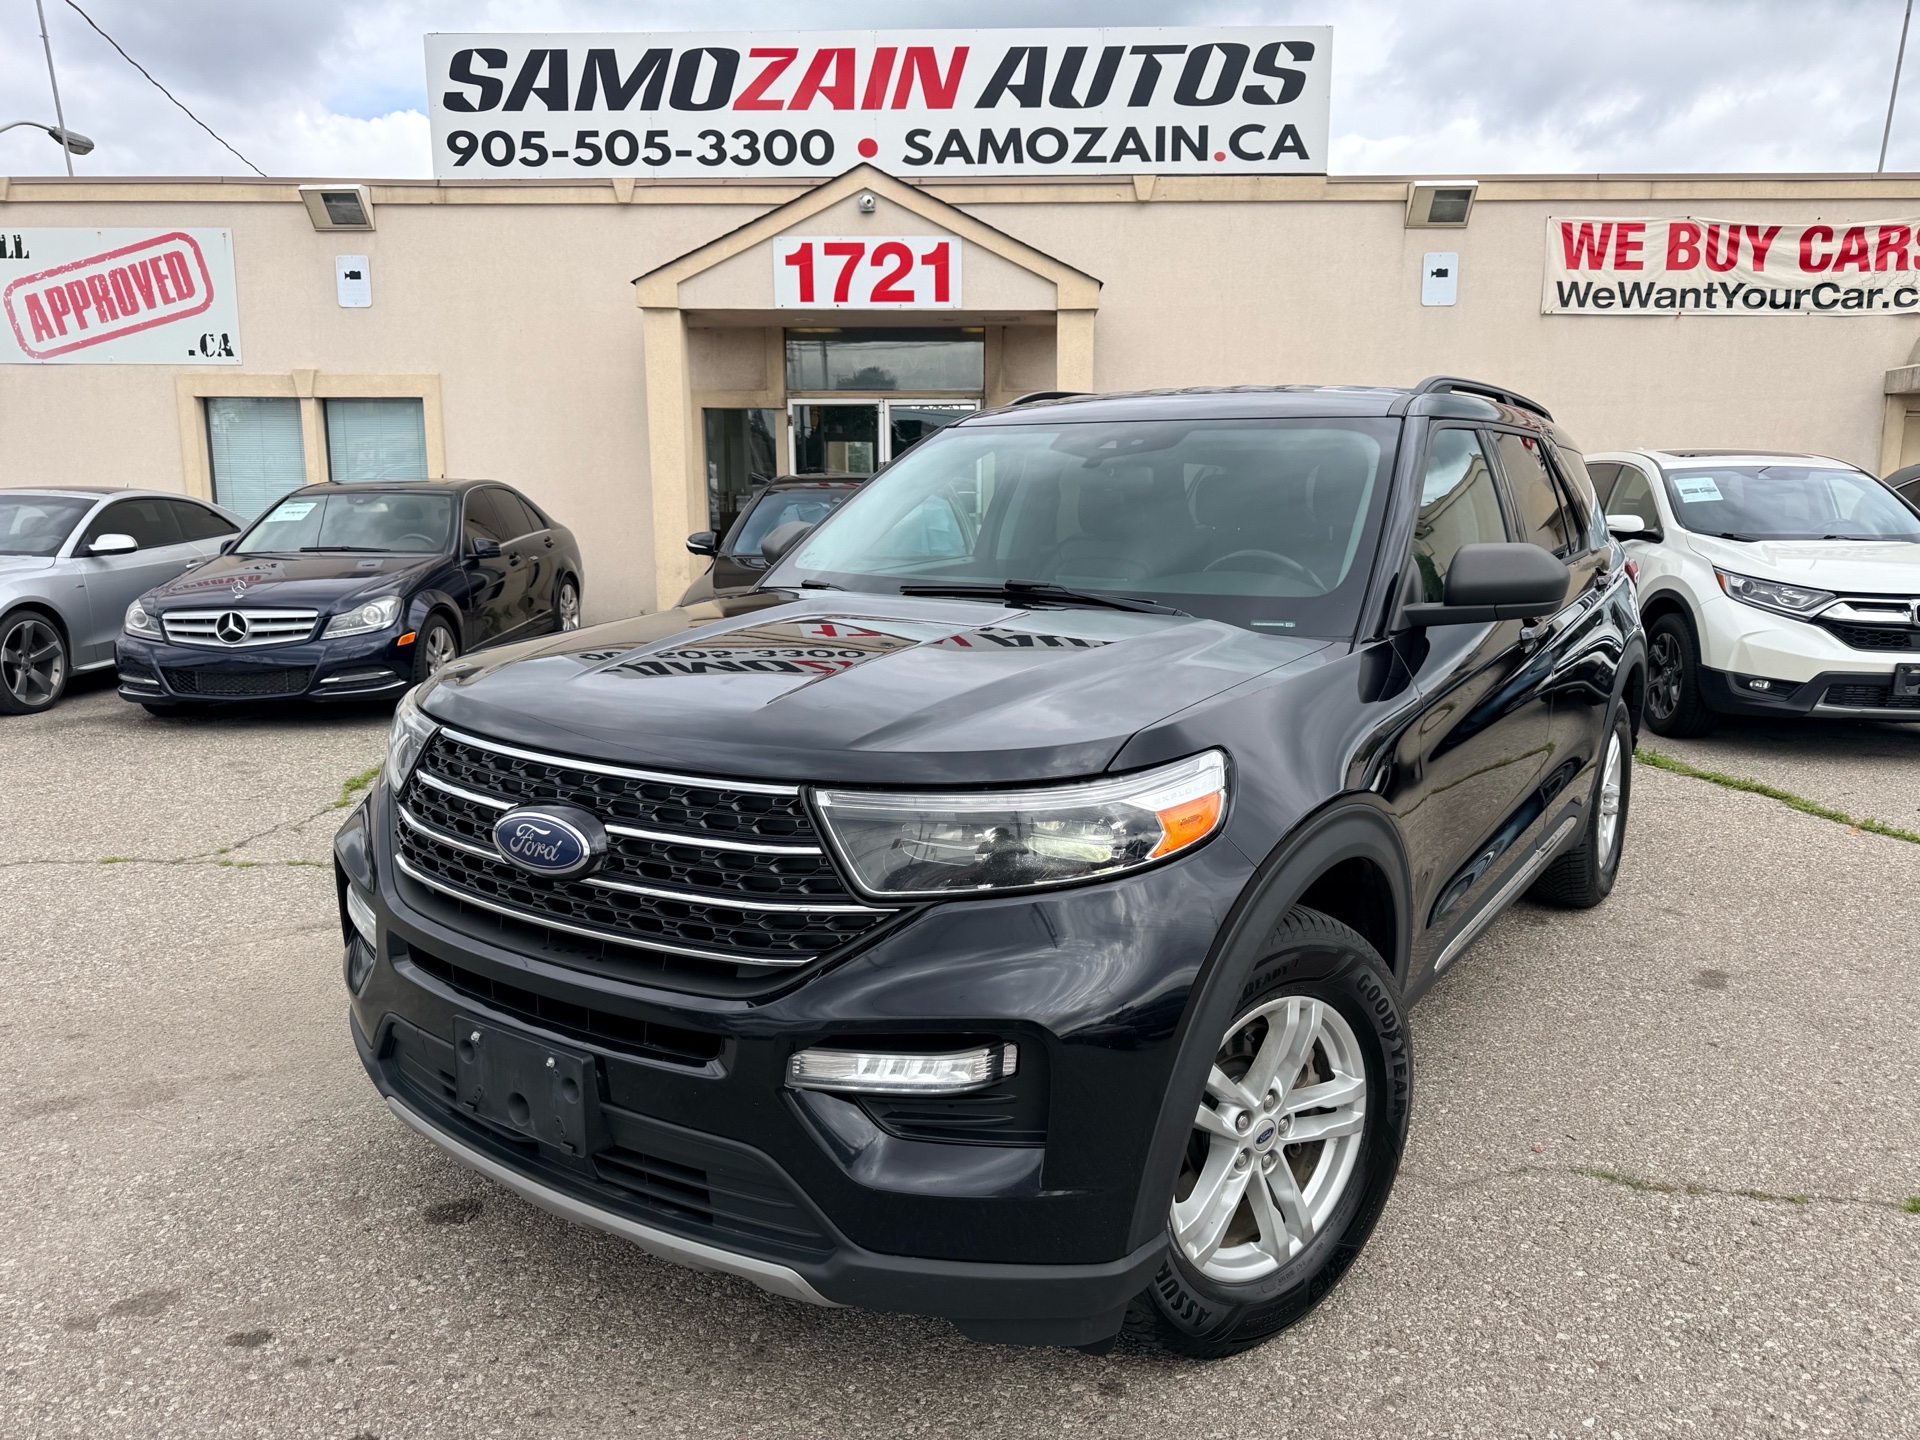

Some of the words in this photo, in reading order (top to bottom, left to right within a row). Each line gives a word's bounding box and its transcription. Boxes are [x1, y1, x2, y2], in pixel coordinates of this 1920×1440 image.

[442, 46, 970, 112] SAMOZAIN
[975, 42, 1315, 108] AUTOS
[446, 130, 835, 167] 905-505-3300
[902, 124, 1310, 165] SAMOZAIN.CA
[785, 242, 949, 303] 1721
[1560, 222, 1646, 271] WE
[1666, 222, 1781, 272] BUY
[1799, 225, 1920, 273] CAR
[24, 250, 196, 343] APPROVED
[1556, 282, 1919, 309] WeWantYourCar.c
[509, 823, 563, 862] Ford
[1356, 973, 1408, 1118] GOODYEAR
